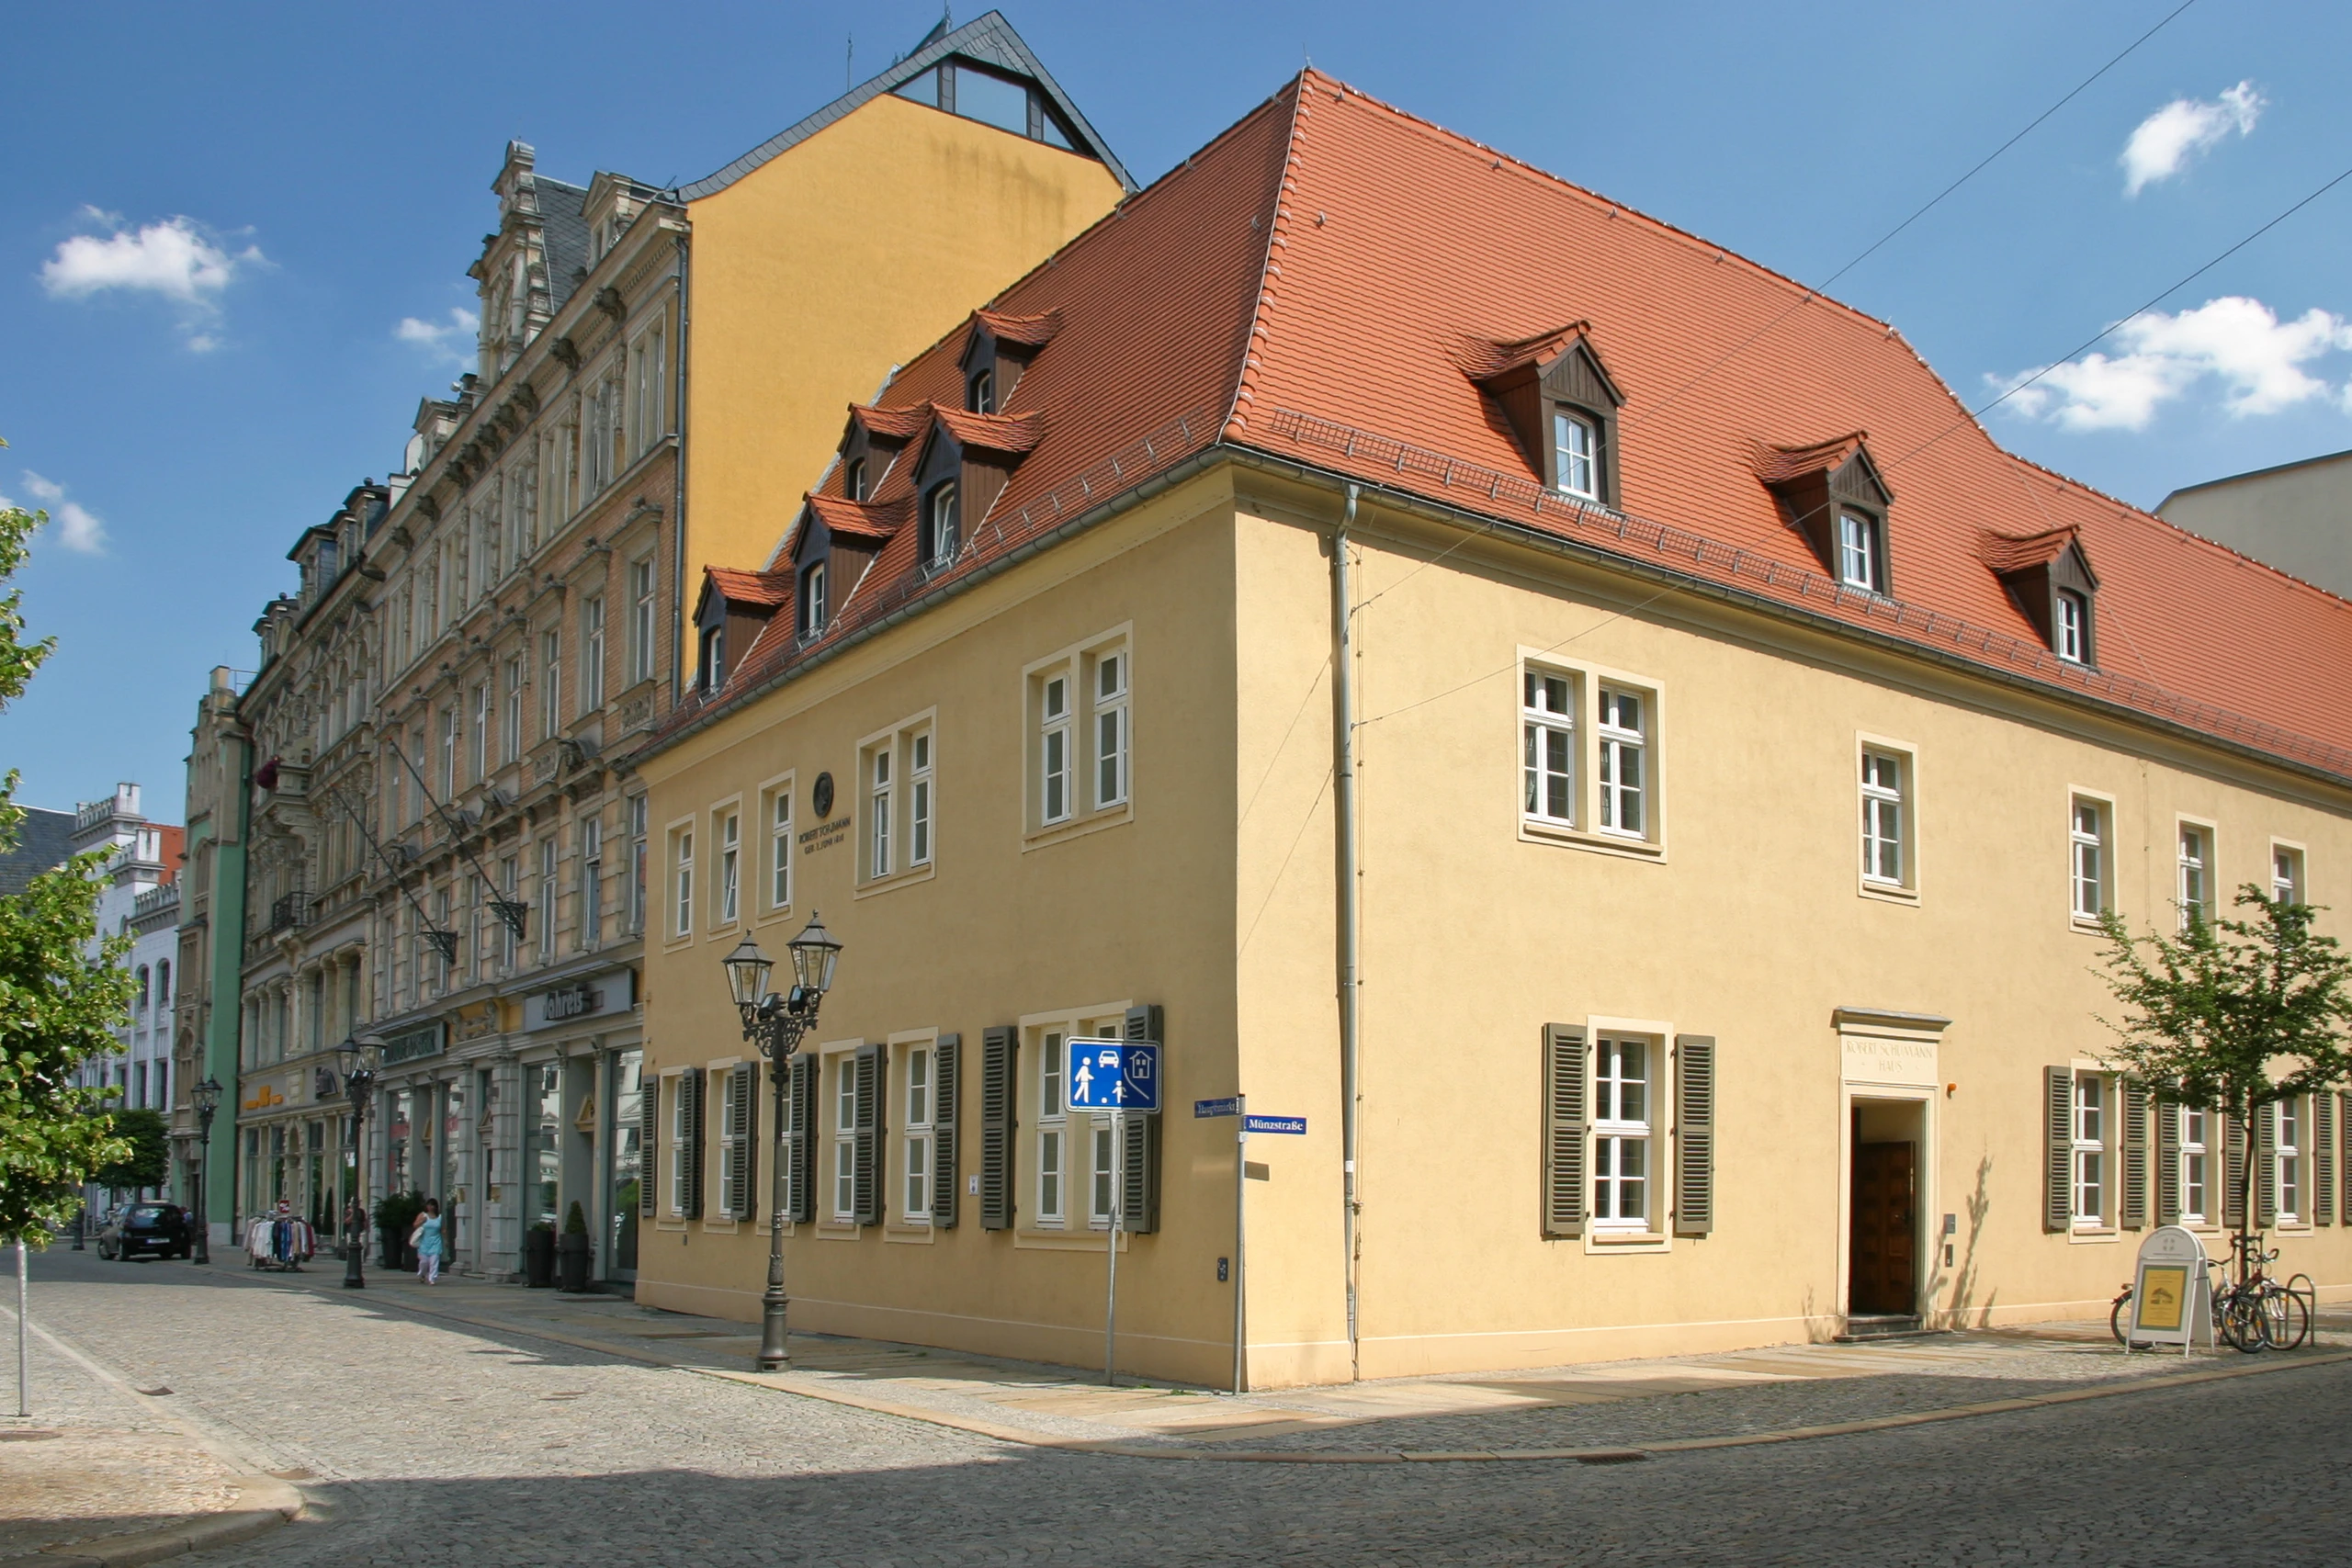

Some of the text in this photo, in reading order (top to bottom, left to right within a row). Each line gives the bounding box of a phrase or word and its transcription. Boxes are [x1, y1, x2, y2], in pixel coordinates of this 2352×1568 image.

[1846, 1040, 1933, 1059] ROBERT SCHUMANN
[1878, 1060, 1904, 1073] HAUS
[1249, 1118, 1304, 1131] Münzstraße
